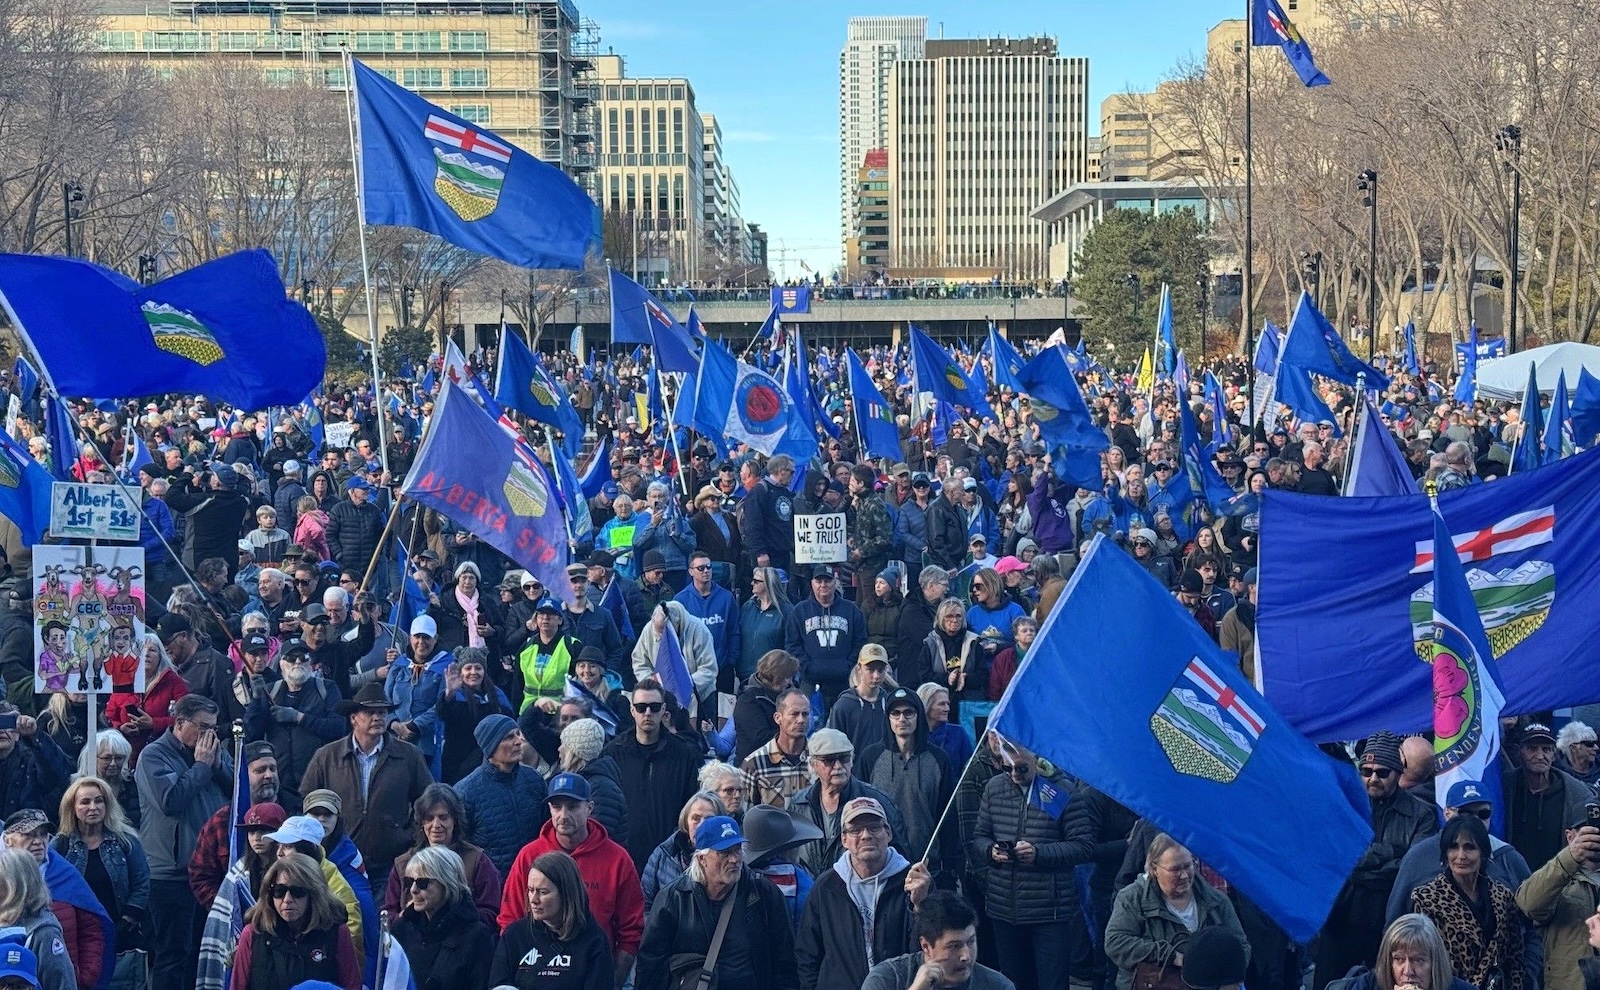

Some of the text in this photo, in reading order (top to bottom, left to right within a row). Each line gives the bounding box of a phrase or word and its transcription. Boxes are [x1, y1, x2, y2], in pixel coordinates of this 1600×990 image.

[63, 486, 126, 509] Alberta
[417, 471, 508, 534] ALBERTA
[67, 505, 94, 526] 1st
[799, 516, 841, 529] IN GOD
[797, 529, 844, 544] WE TRUST
[77, 603, 101, 614] CBC
[816, 629, 839, 647] W
